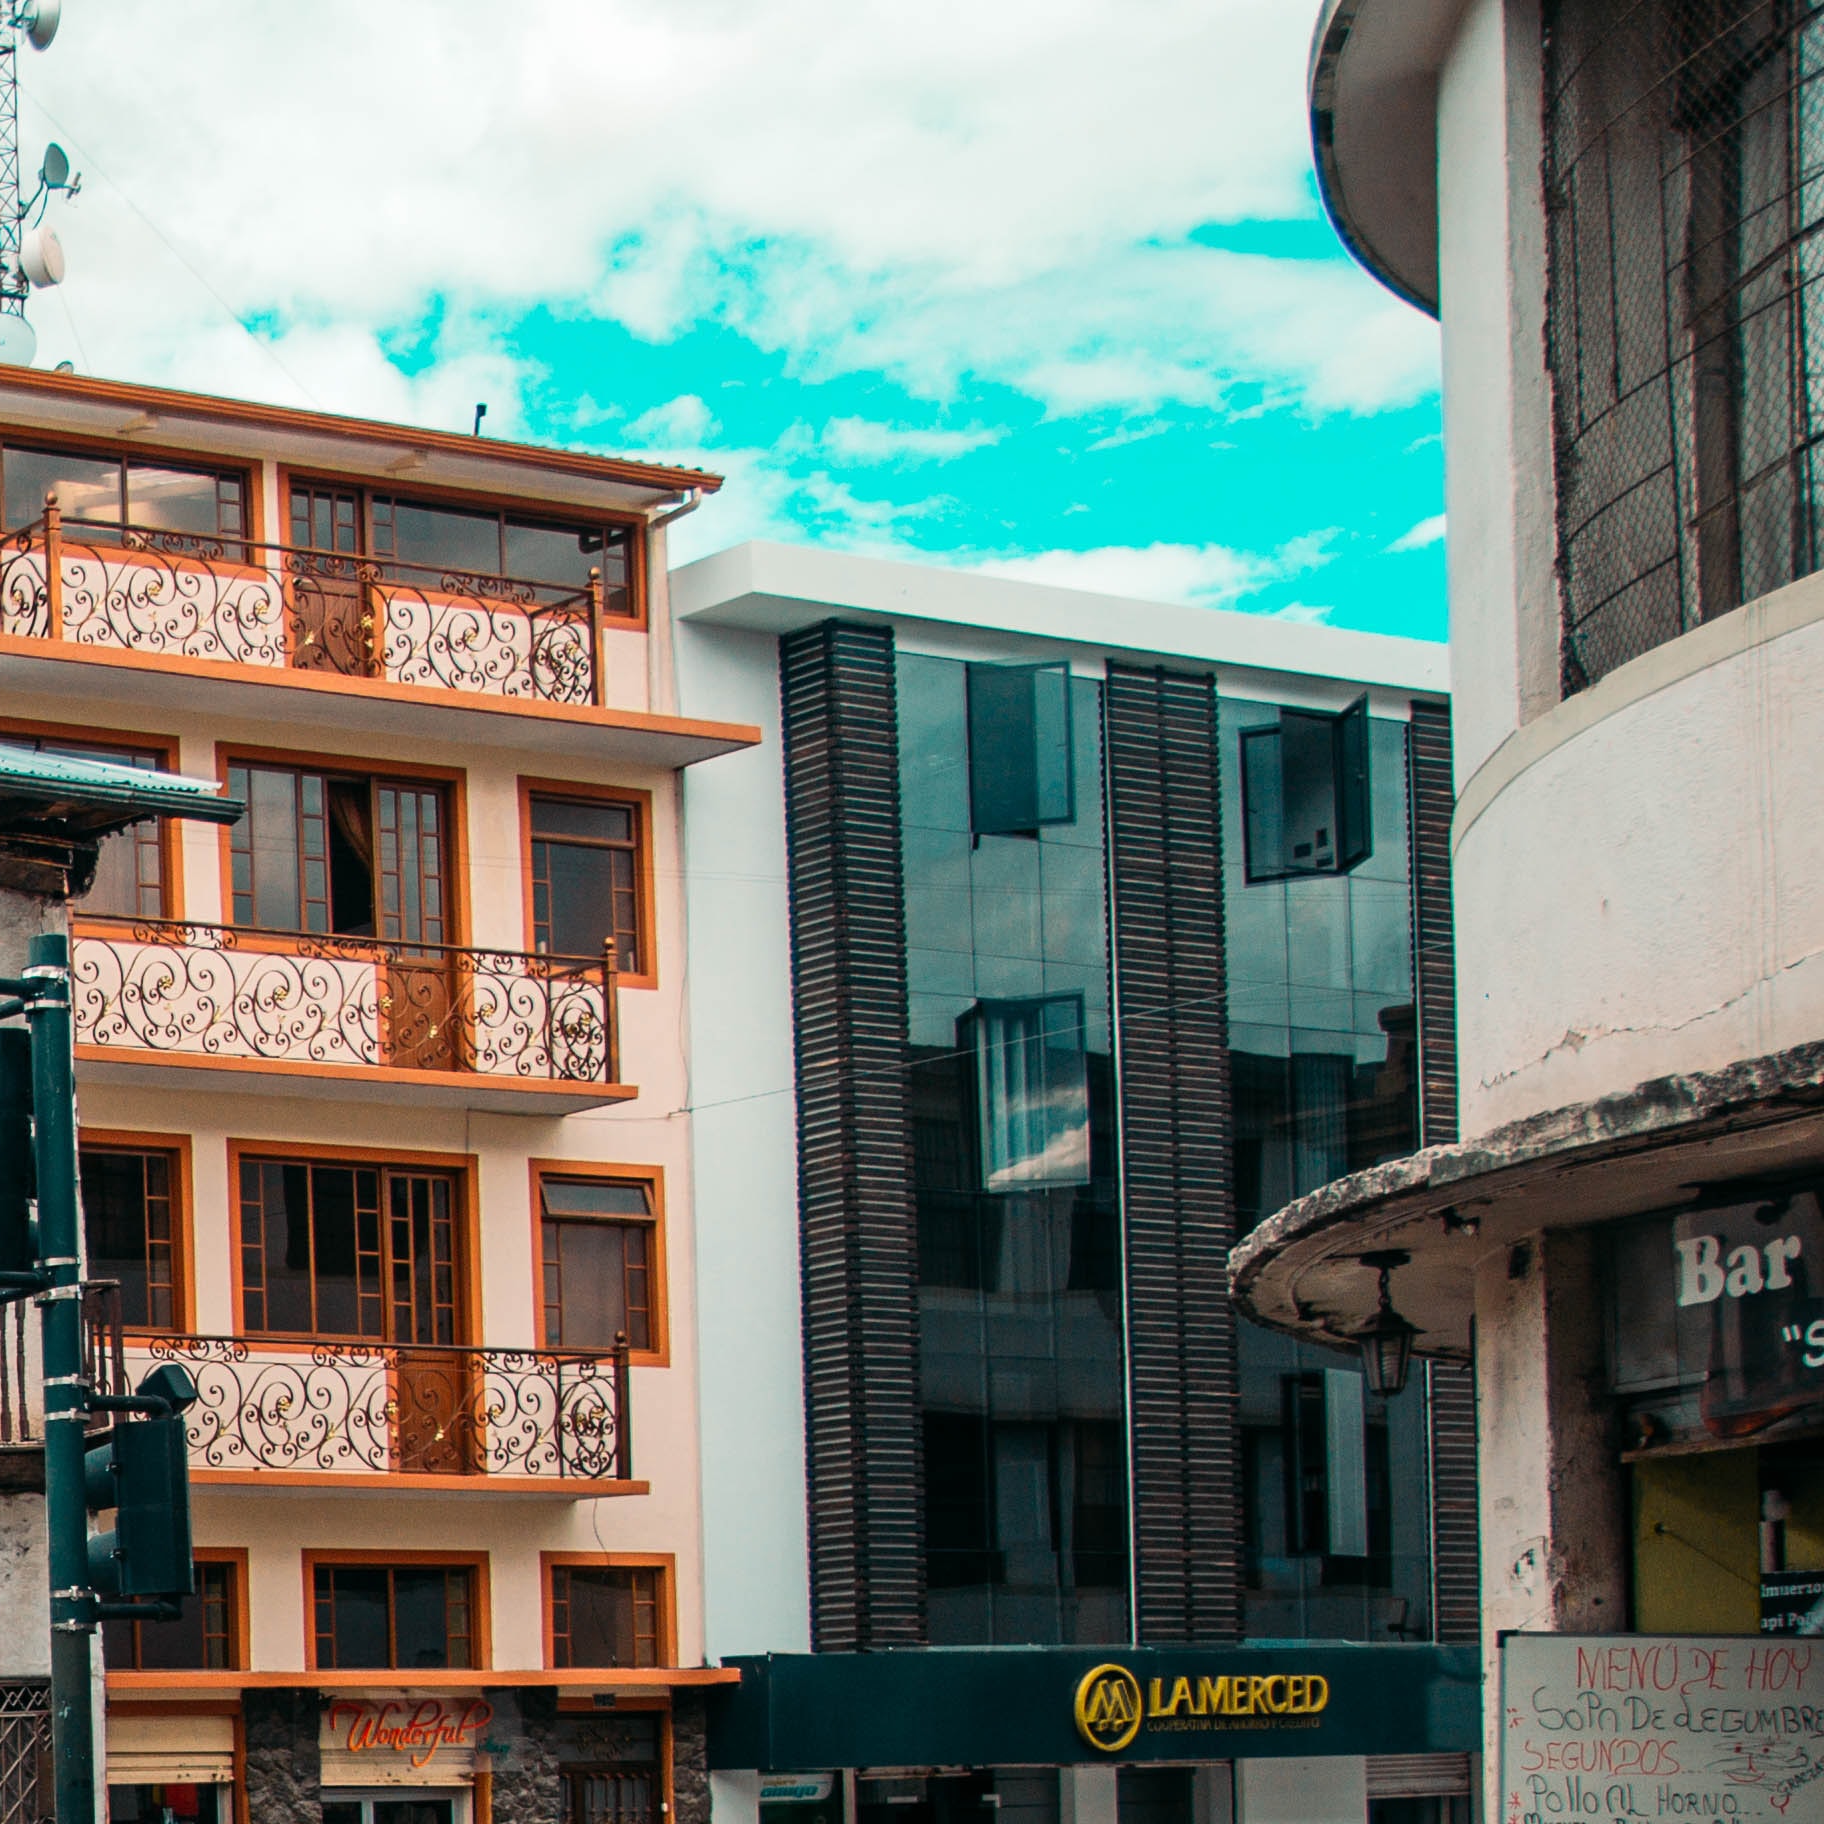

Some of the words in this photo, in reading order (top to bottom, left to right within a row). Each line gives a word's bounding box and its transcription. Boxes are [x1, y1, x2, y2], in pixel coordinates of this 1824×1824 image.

[1675, 1235, 1801, 1307] Bar
[1577, 1642, 1678, 1691] MENÚ
[1680, 1647, 1729, 1695] DE
[1745, 1645, 1812, 1691] HOY
[330, 1701, 494, 1769] Wonderful
